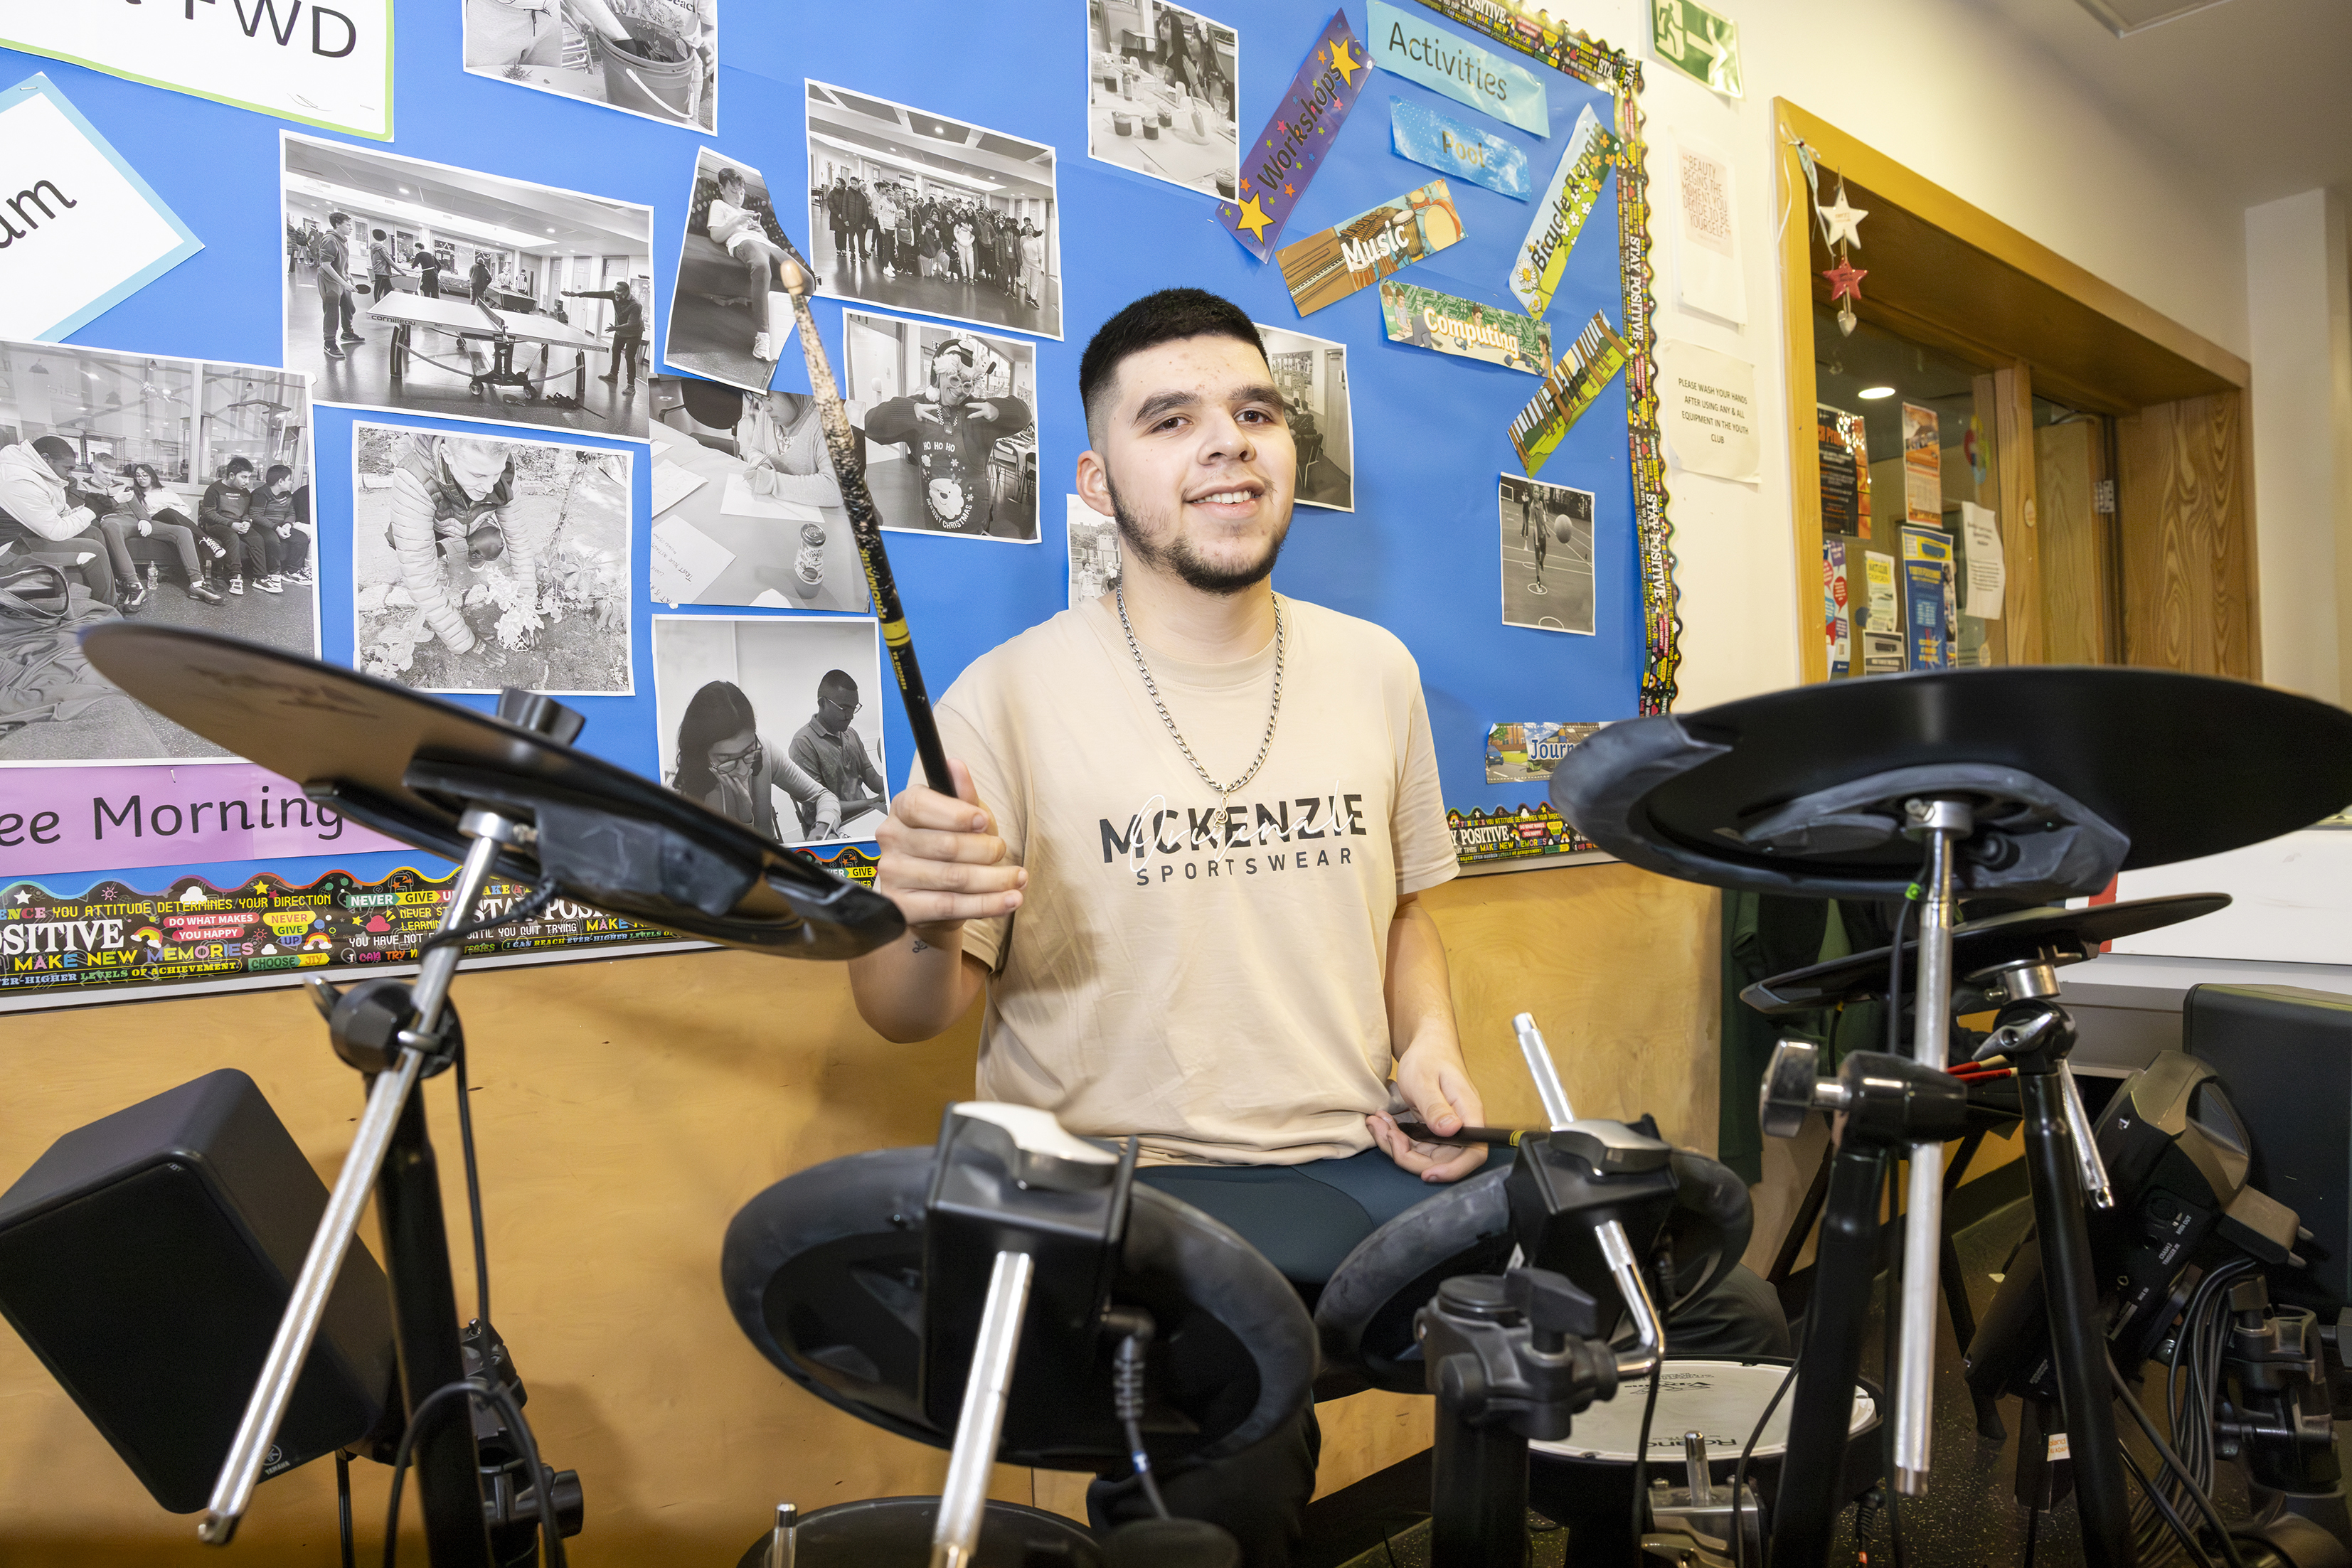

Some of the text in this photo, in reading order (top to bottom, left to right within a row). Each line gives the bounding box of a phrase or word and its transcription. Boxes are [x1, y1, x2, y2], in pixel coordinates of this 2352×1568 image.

[1476, 12, 1509, 34] MAKE NEW
[1389, 21, 1508, 100] Activities
[1257, 60, 1343, 191] Workshops
[1440, 130, 1486, 170] Pool
[1683, 166, 1723, 198] BEGINS THE
[1682, 181, 1727, 213] MOMENT YOU
[1683, 195, 1729, 227] DECIDE TO BE
[1531, 196, 1571, 273] Bicycle
[1341, 221, 1410, 273] Music
[1630, 236, 1644, 341] STAY POSITIVE
[1423, 306, 1521, 359] Computing
[1678, 378, 1747, 405] PLEASE WASH YOUR HANDS
[1684, 395, 1701, 407] AFTER
[1702, 400, 1718, 411] USING
[1720, 405, 1730, 414] ANY
[1682, 411, 1713, 425] EQUIPMENT
[1722, 420, 1732, 430] THE
[1733, 423, 1749, 434] YOUTH
[923, 442, 955, 452] HO HO HO
[1711, 434, 1725, 444] CLUB
[1655, 481, 1660, 491] UP
[926, 498, 972, 529] MERRY CHRISTMAS
[1646, 494, 1666, 598] STAY POSITIVE
[859, 548, 887, 619] PROMARK
[93, 785, 344, 840] Morning
[1099, 794, 1367, 863] MCKENZIE
[1461, 826, 1509, 844] POSITIVE
[1479, 838, 1547, 852] MAKE NEW MEMORIES
[853, 868, 872, 876] GIVE
[1137, 848, 1352, 885] SPORTSWEAR
[53, 906, 78, 918] YOU
[85, 902, 151, 917] ATTITUDE
[157, 898, 233, 913] DETERMINES
[239, 897, 268, 910] YOUR
[274, 894, 331, 907] DIRECTION
[351, 895, 393, 907] NEVER
[405, 892, 433, 902] GIVE
[169, 914, 253, 927] DO WHAT MAKES
[272, 914, 308, 924] NEVER
[400, 908, 432, 918] NEVER
[0, 919, 124, 956] SITIVE
[179, 929, 238, 940] YOU HAPPY
[277, 925, 303, 934] GIVE
[498, 927, 516, 937] YOU
[521, 924, 539, 935] QUIT
[546, 923, 578, 934] TRYING
[586, 918, 628, 932] MAKE
[567, 933, 628, 944] EVER-HIGHER
[629, 930, 662, 939] LEVELS
[284, 937, 300, 945] UP
[349, 933, 423, 948] YOU HAVE NOT
[14, 942, 254, 971] MAKE NEW MEMORIES
[251, 956, 296, 969] CHOOSE
[359, 951, 381, 962] CAN
[385, 950, 405, 960] TRY
[0, 961, 236, 986] ER-HIGHER LEVELS OF ACHIEVEMENT
[265, 1461, 290, 1475] YAMAHA
